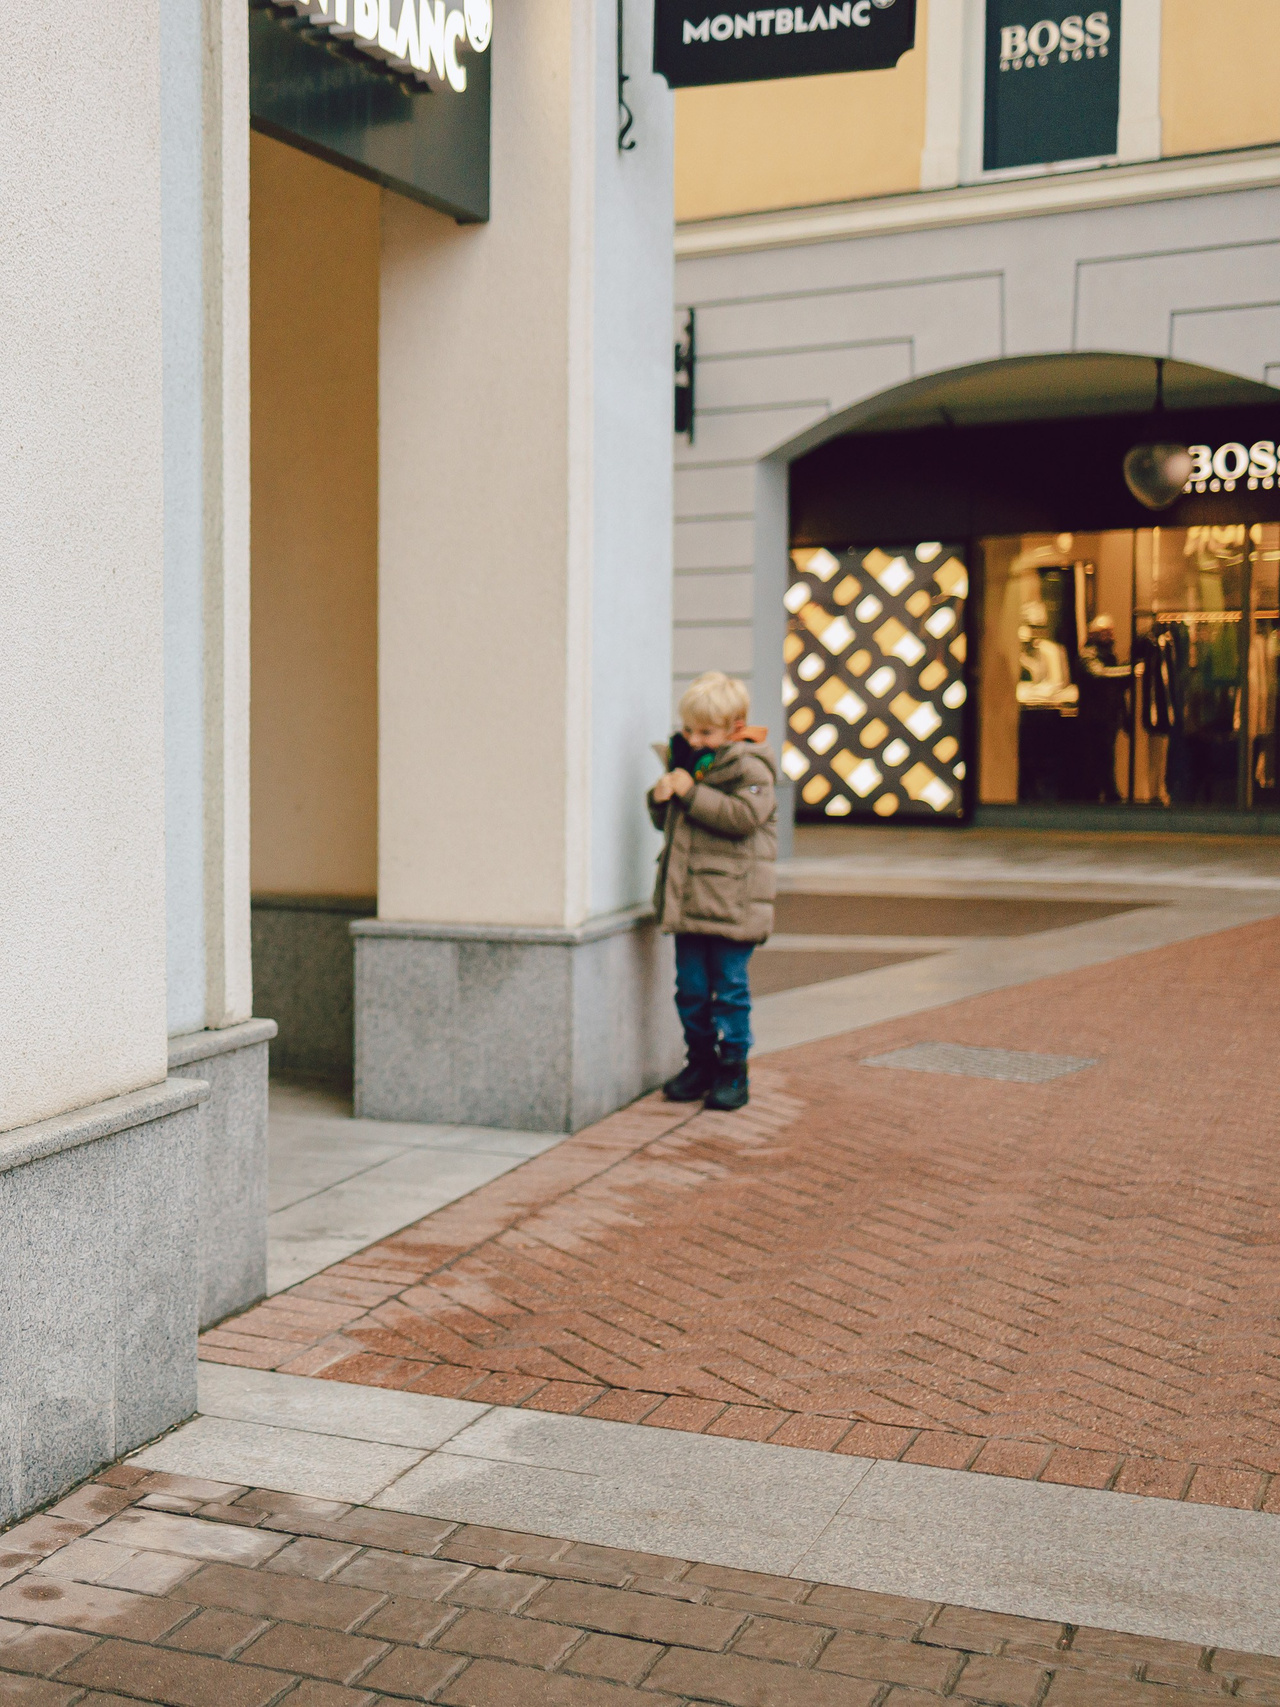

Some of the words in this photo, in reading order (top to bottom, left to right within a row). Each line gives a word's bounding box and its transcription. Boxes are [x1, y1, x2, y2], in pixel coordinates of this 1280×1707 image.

[682, 1, 870, 44] MONTBLANC
[1000, 11, 1111, 60] BOSS
[298, 0, 468, 93] BLANC
[1187, 440, 1280, 482] BOS
